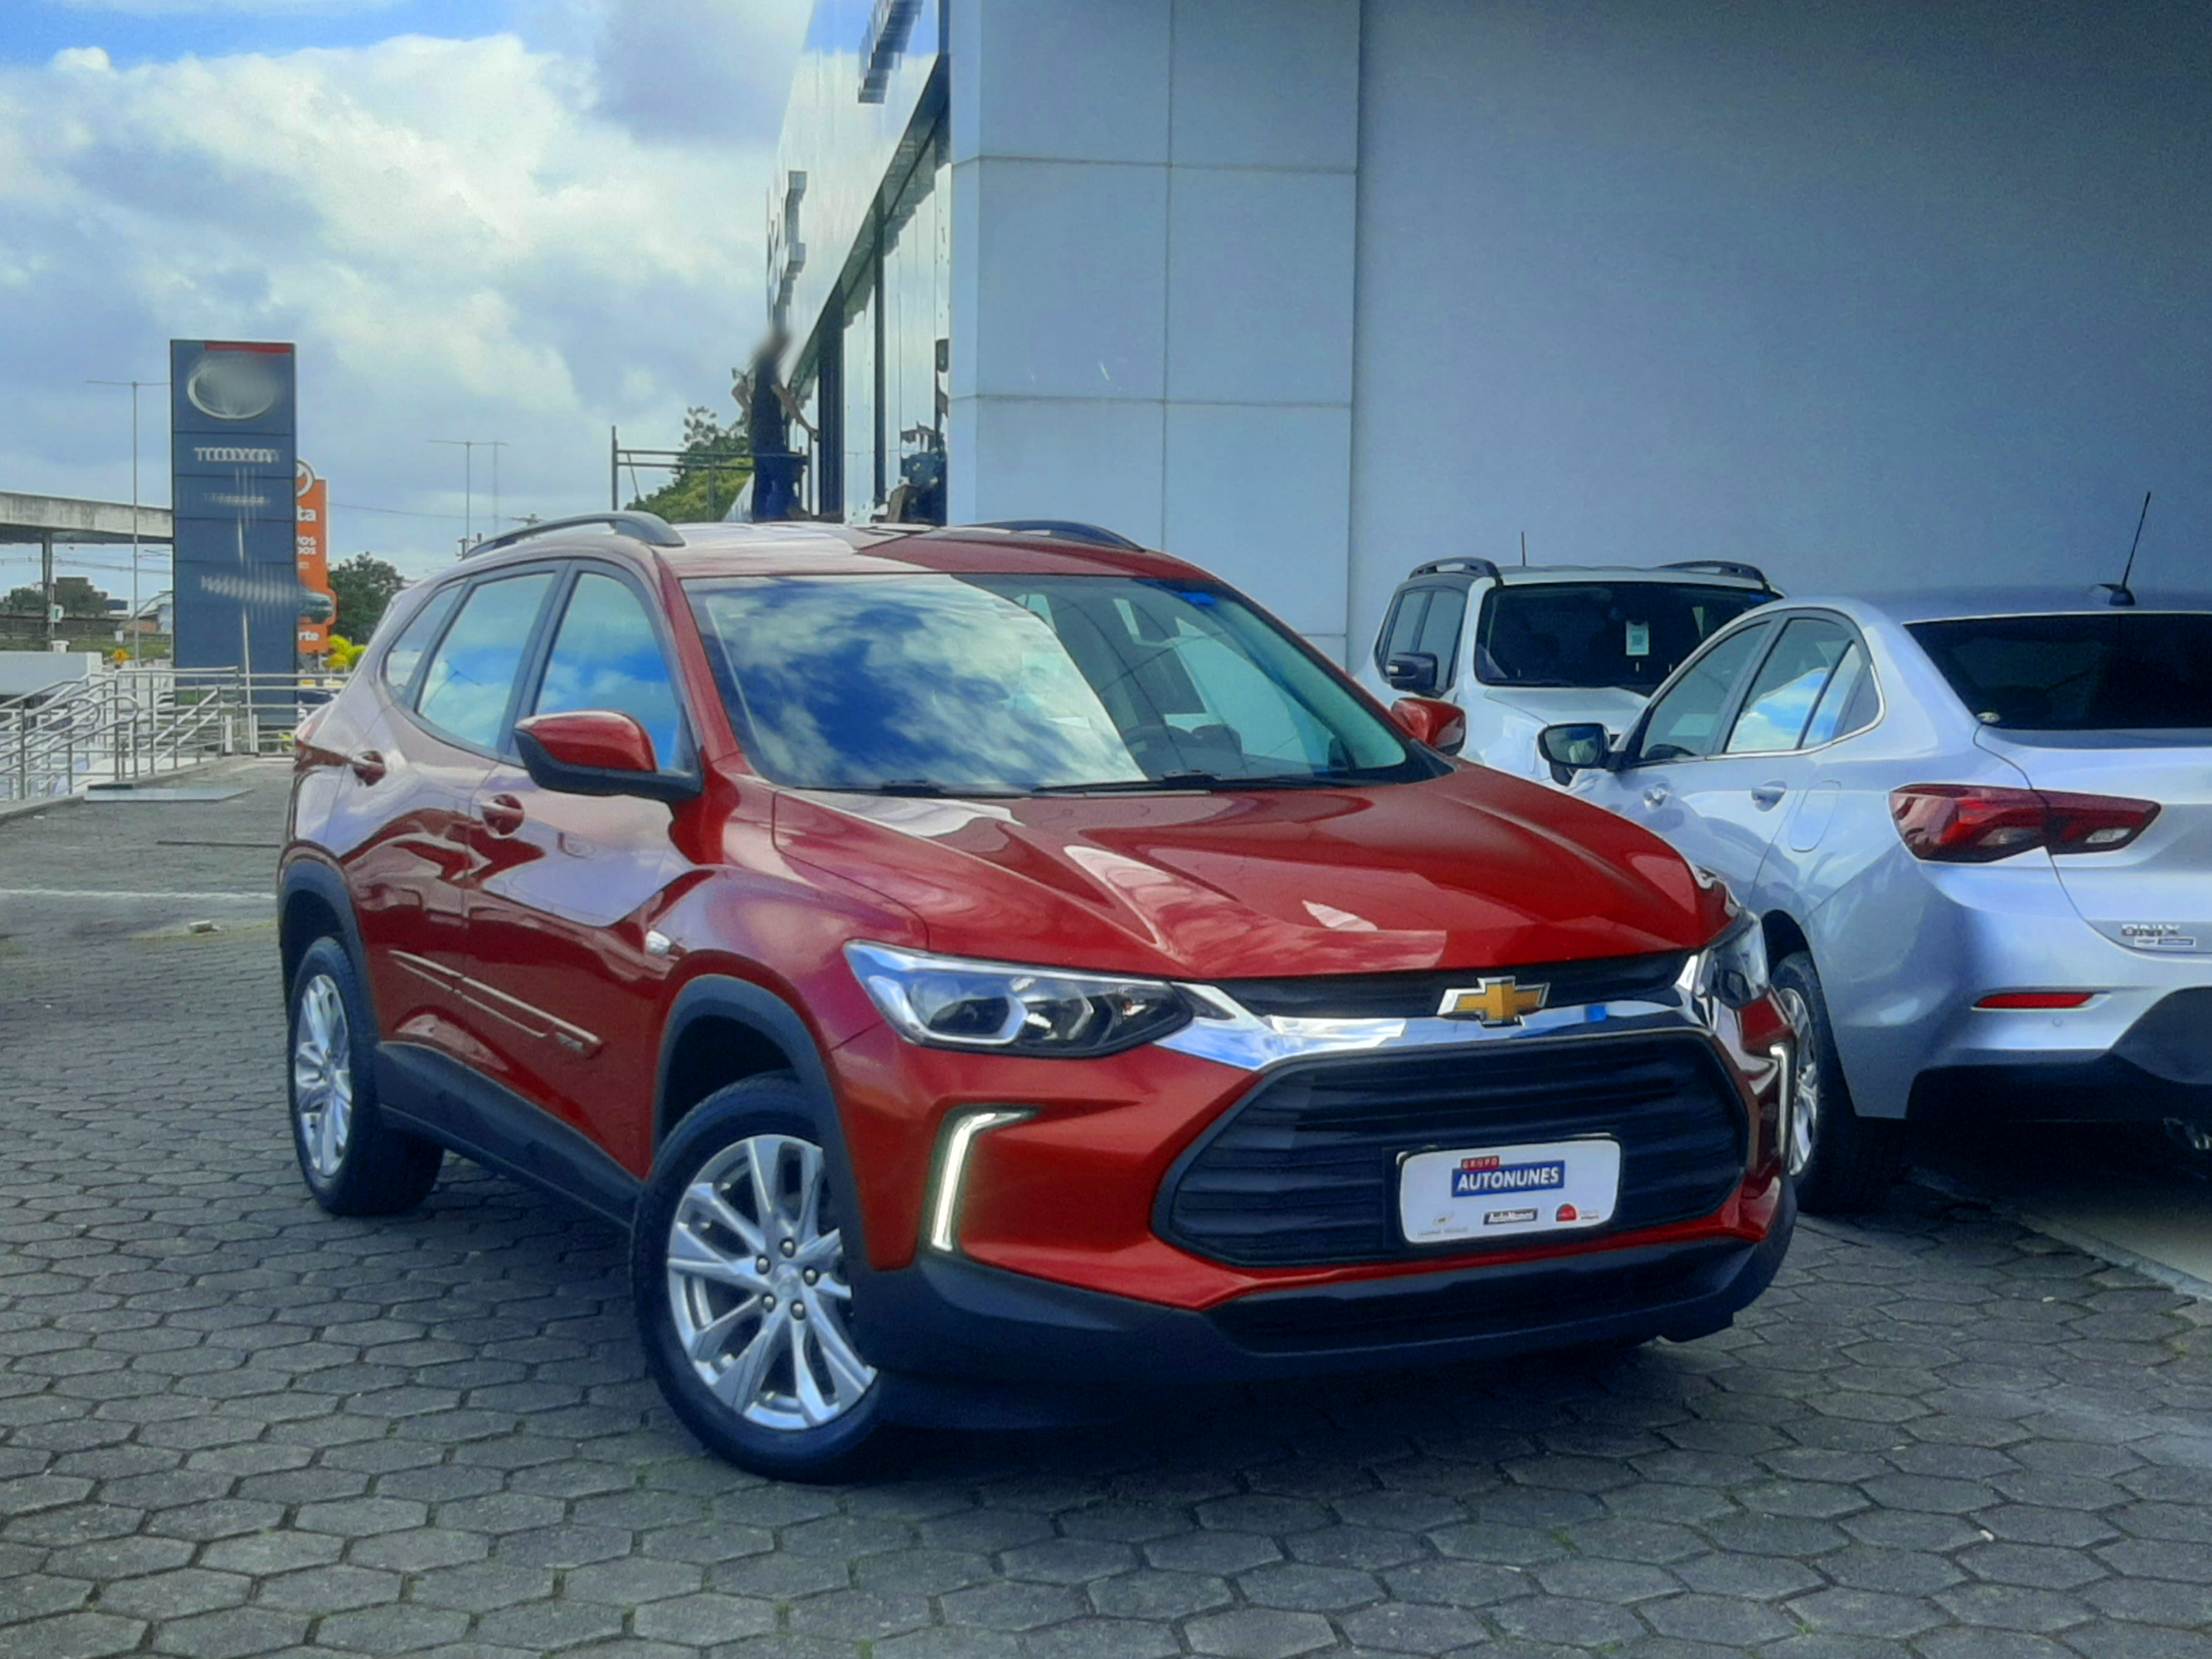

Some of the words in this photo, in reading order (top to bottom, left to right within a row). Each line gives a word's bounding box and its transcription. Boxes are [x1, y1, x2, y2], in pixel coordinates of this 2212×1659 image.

[2121, 924, 2180, 936] ONIX
[1463, 1157, 1498, 1169] GRUPO
[1457, 1167, 1559, 1191] AUTONUNES
